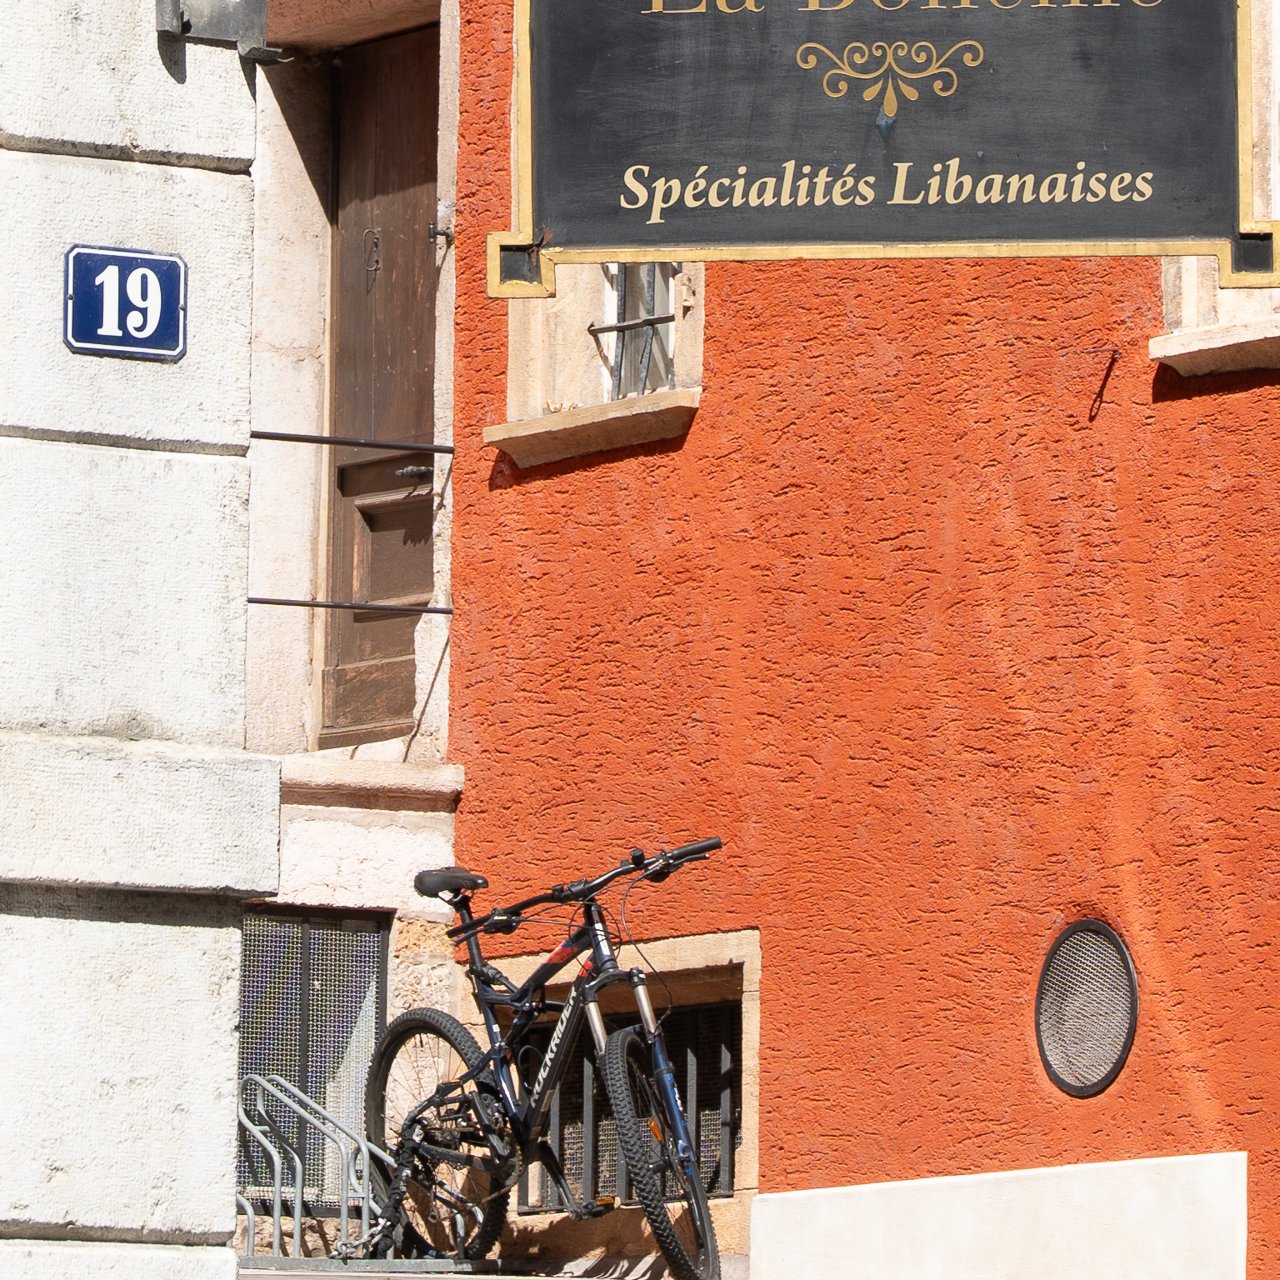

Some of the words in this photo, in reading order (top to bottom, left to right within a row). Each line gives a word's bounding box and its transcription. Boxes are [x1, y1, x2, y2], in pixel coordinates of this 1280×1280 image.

[620, 159, 876, 225] Spécialités
[886, 157, 1155, 206] Libanaises
[95, 264, 162, 338] 19
